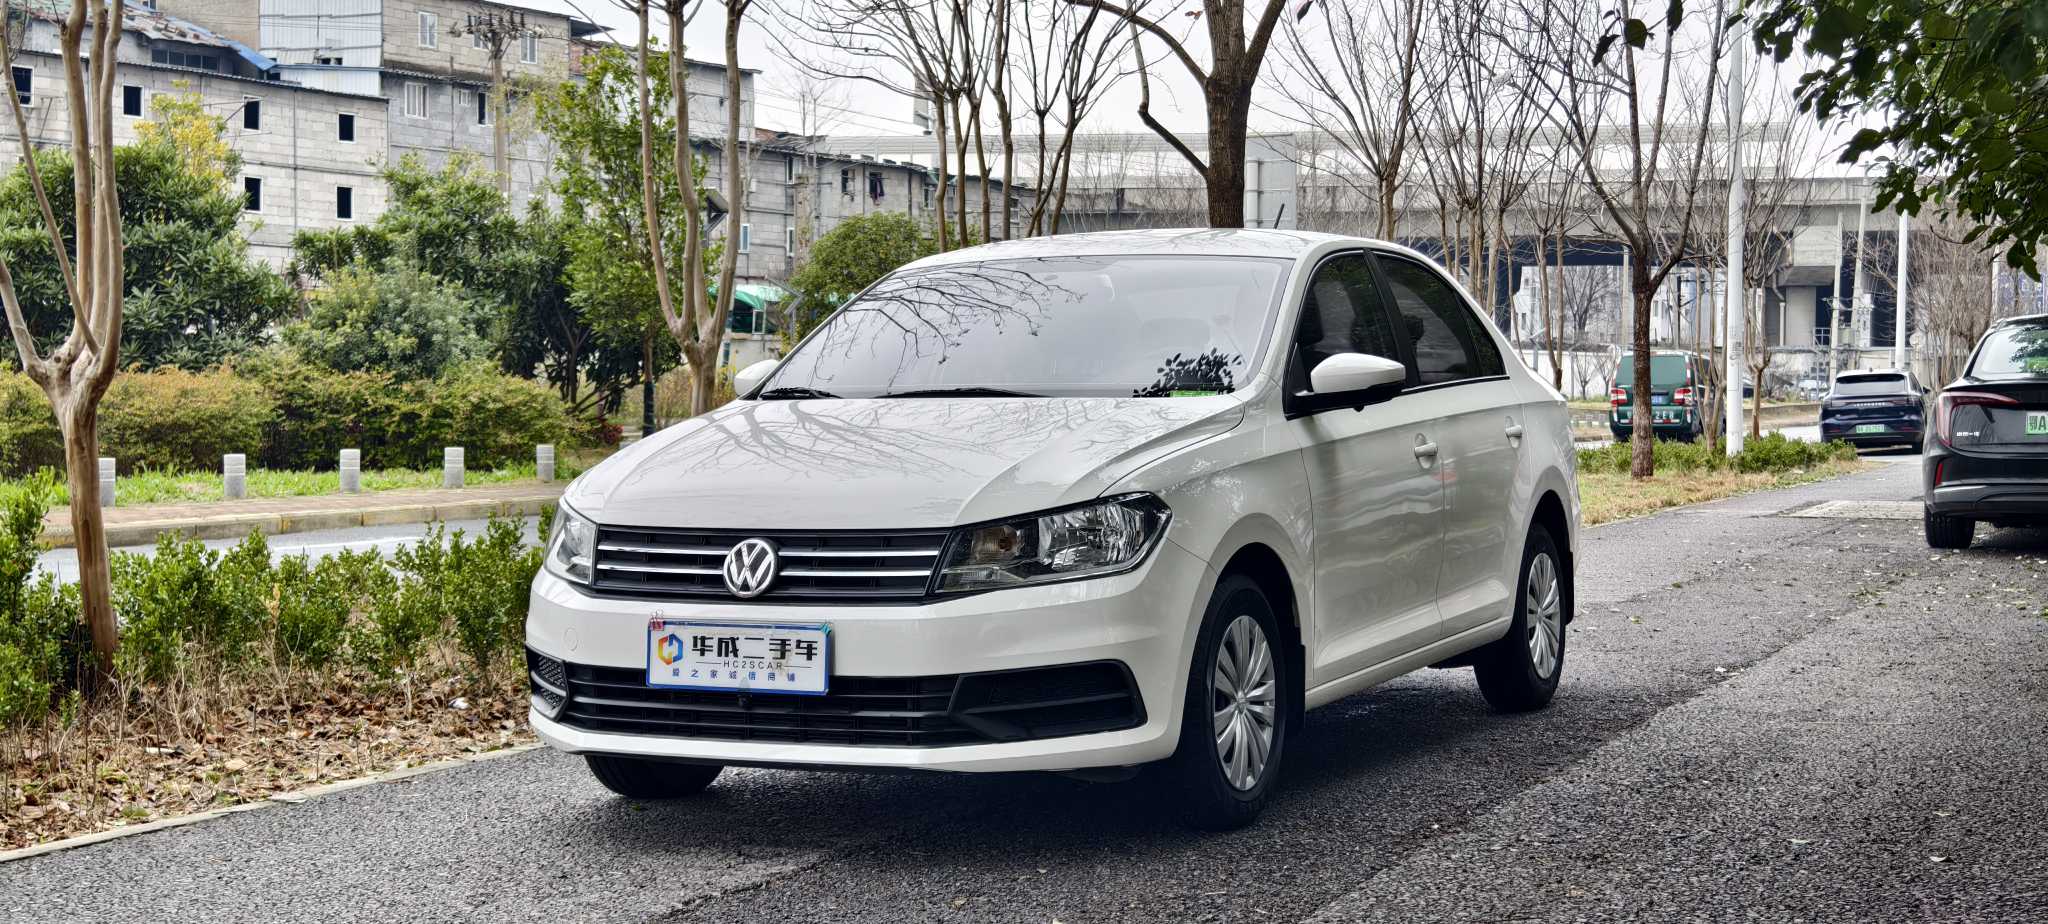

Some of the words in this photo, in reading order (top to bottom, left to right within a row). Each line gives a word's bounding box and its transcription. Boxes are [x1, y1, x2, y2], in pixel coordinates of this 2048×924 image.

[724, 538, 775, 598] VW
[691, 635, 818, 661] 华成二手车
[723, 661, 783, 669] HC2SCAR
